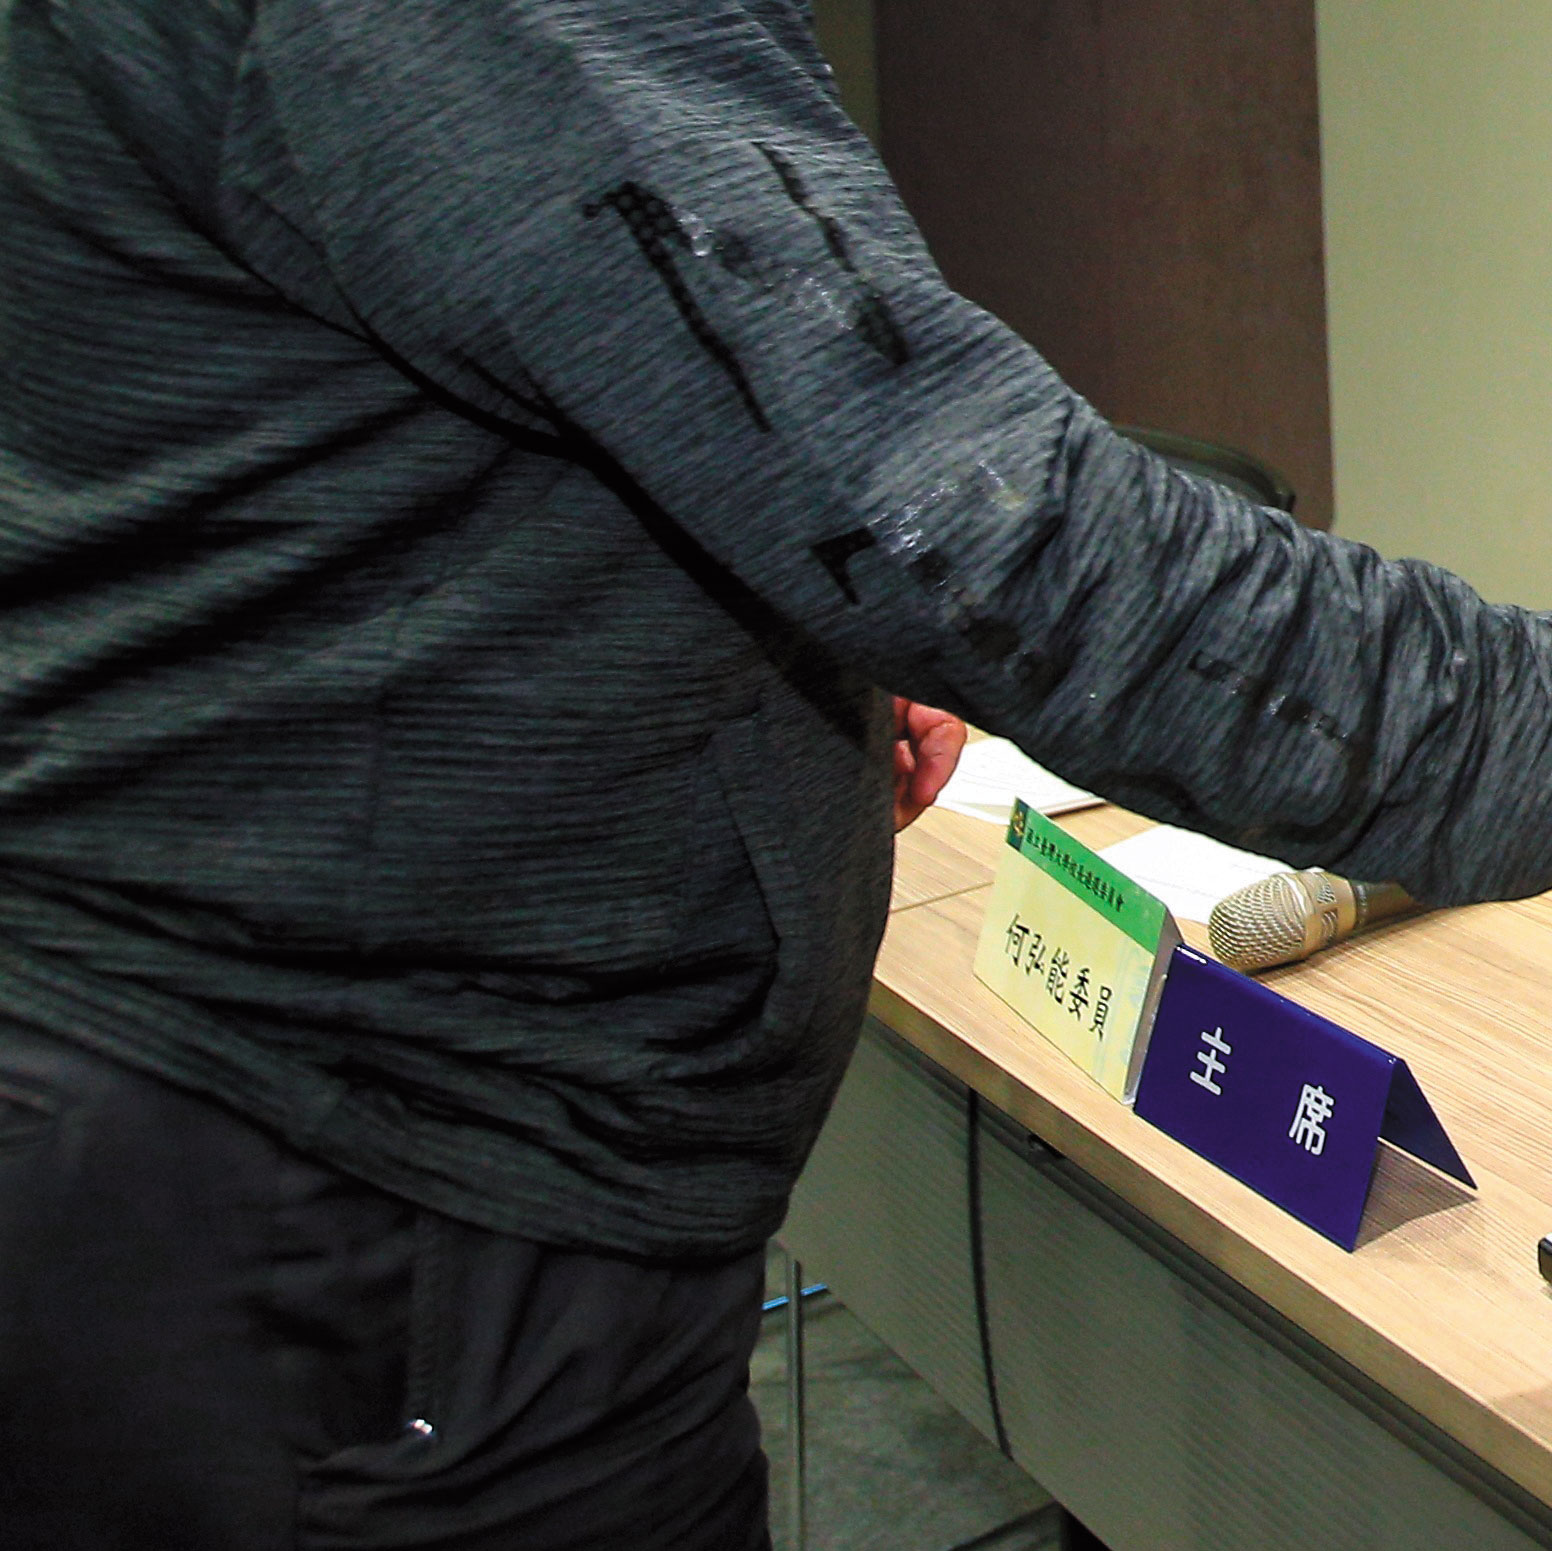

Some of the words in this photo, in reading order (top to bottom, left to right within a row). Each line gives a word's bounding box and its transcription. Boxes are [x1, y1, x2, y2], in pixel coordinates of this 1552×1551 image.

[1005, 912, 1113, 1042] 何弘能委員
[1190, 1027, 1336, 1156] 主席
